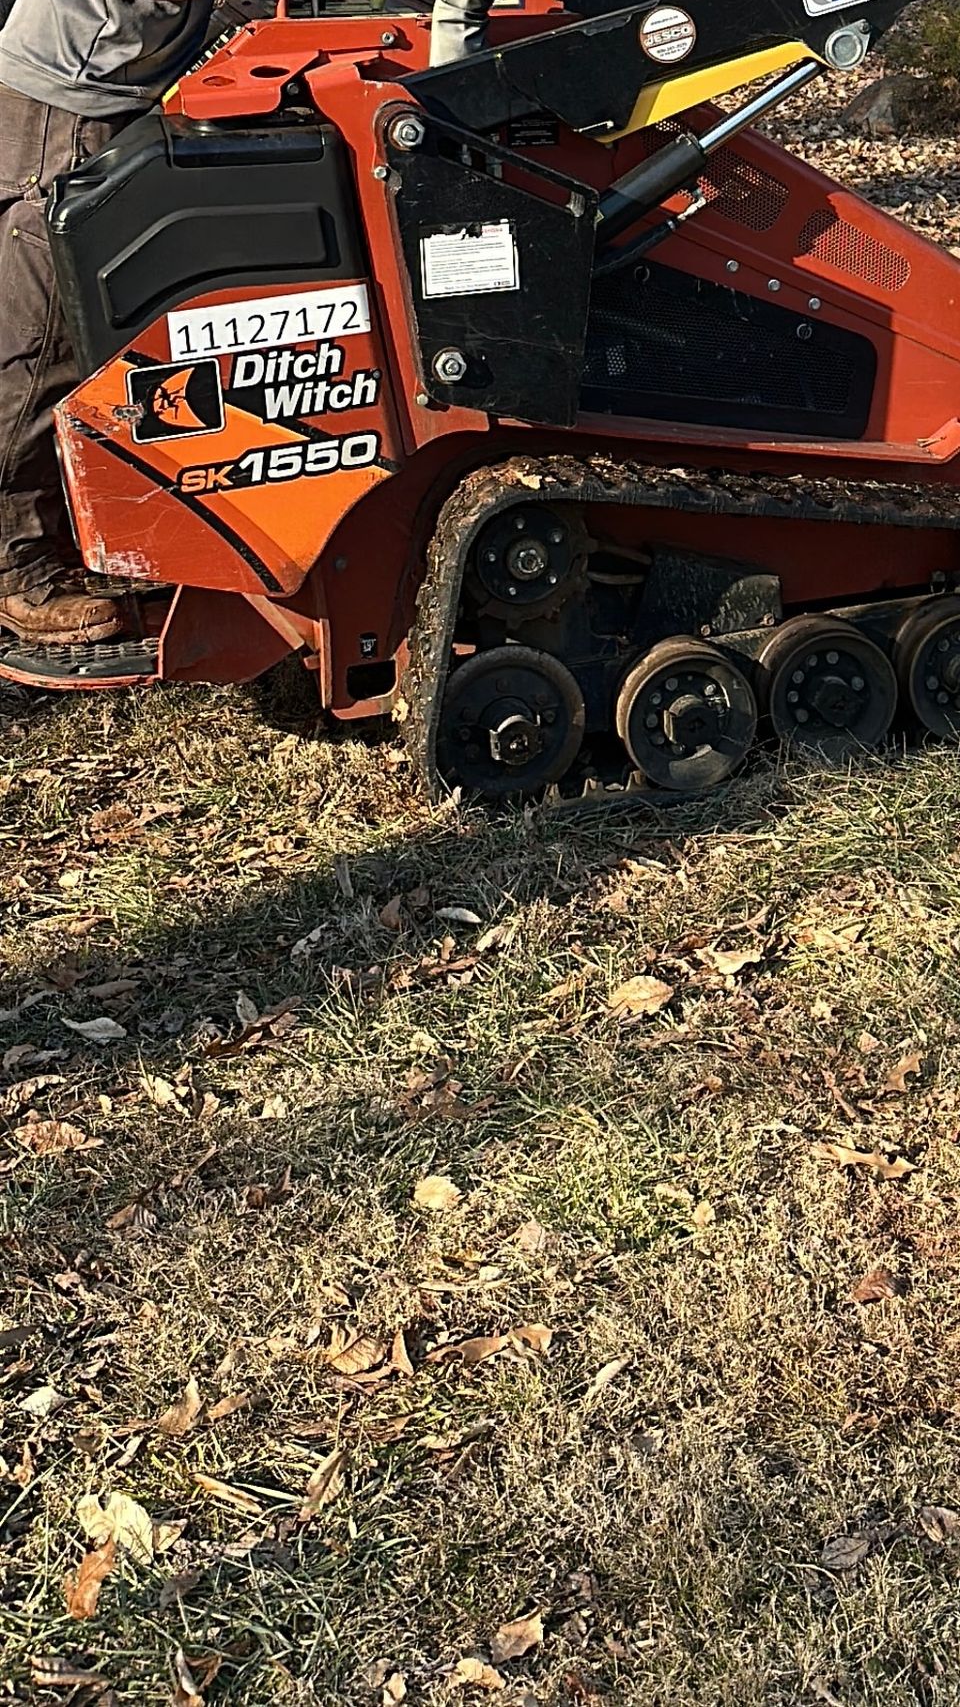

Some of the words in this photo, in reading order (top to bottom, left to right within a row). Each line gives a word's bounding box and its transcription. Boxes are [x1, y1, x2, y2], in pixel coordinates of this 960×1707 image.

[645, 25, 691, 46] JESCO
[177, 300, 360, 355] 11127172
[233, 342, 341, 388] Ditch
[264, 373, 378, 420] Witch
